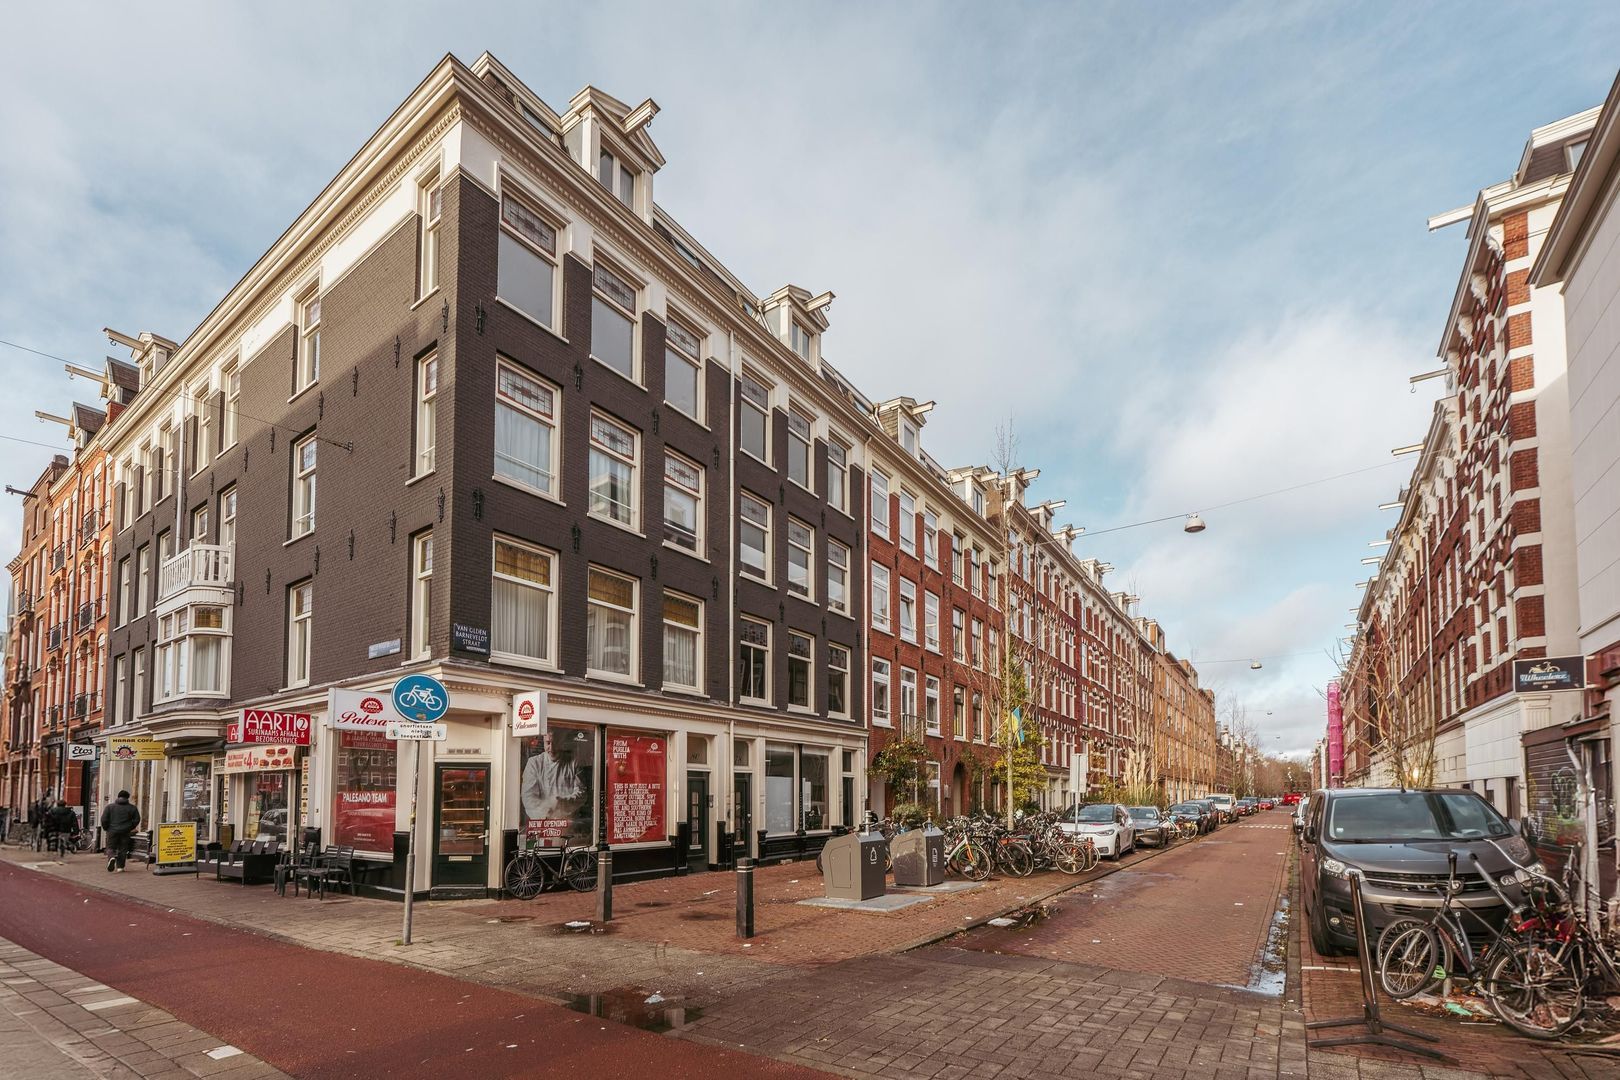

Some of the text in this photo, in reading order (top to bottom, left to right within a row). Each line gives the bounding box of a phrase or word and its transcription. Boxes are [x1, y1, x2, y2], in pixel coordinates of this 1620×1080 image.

[462, 639, 481, 647] STRAAT
[246, 711, 296, 732] AARTI
[337, 710, 395, 726] Palesa
[248, 728, 279, 737] SURINAAMS
[256, 735, 298, 744] BEZORGSERVICE
[72, 746, 93, 756] Etos
[342, 792, 388, 803] PALESANO TEAM
[544, 820, 567, 828] OPENING
